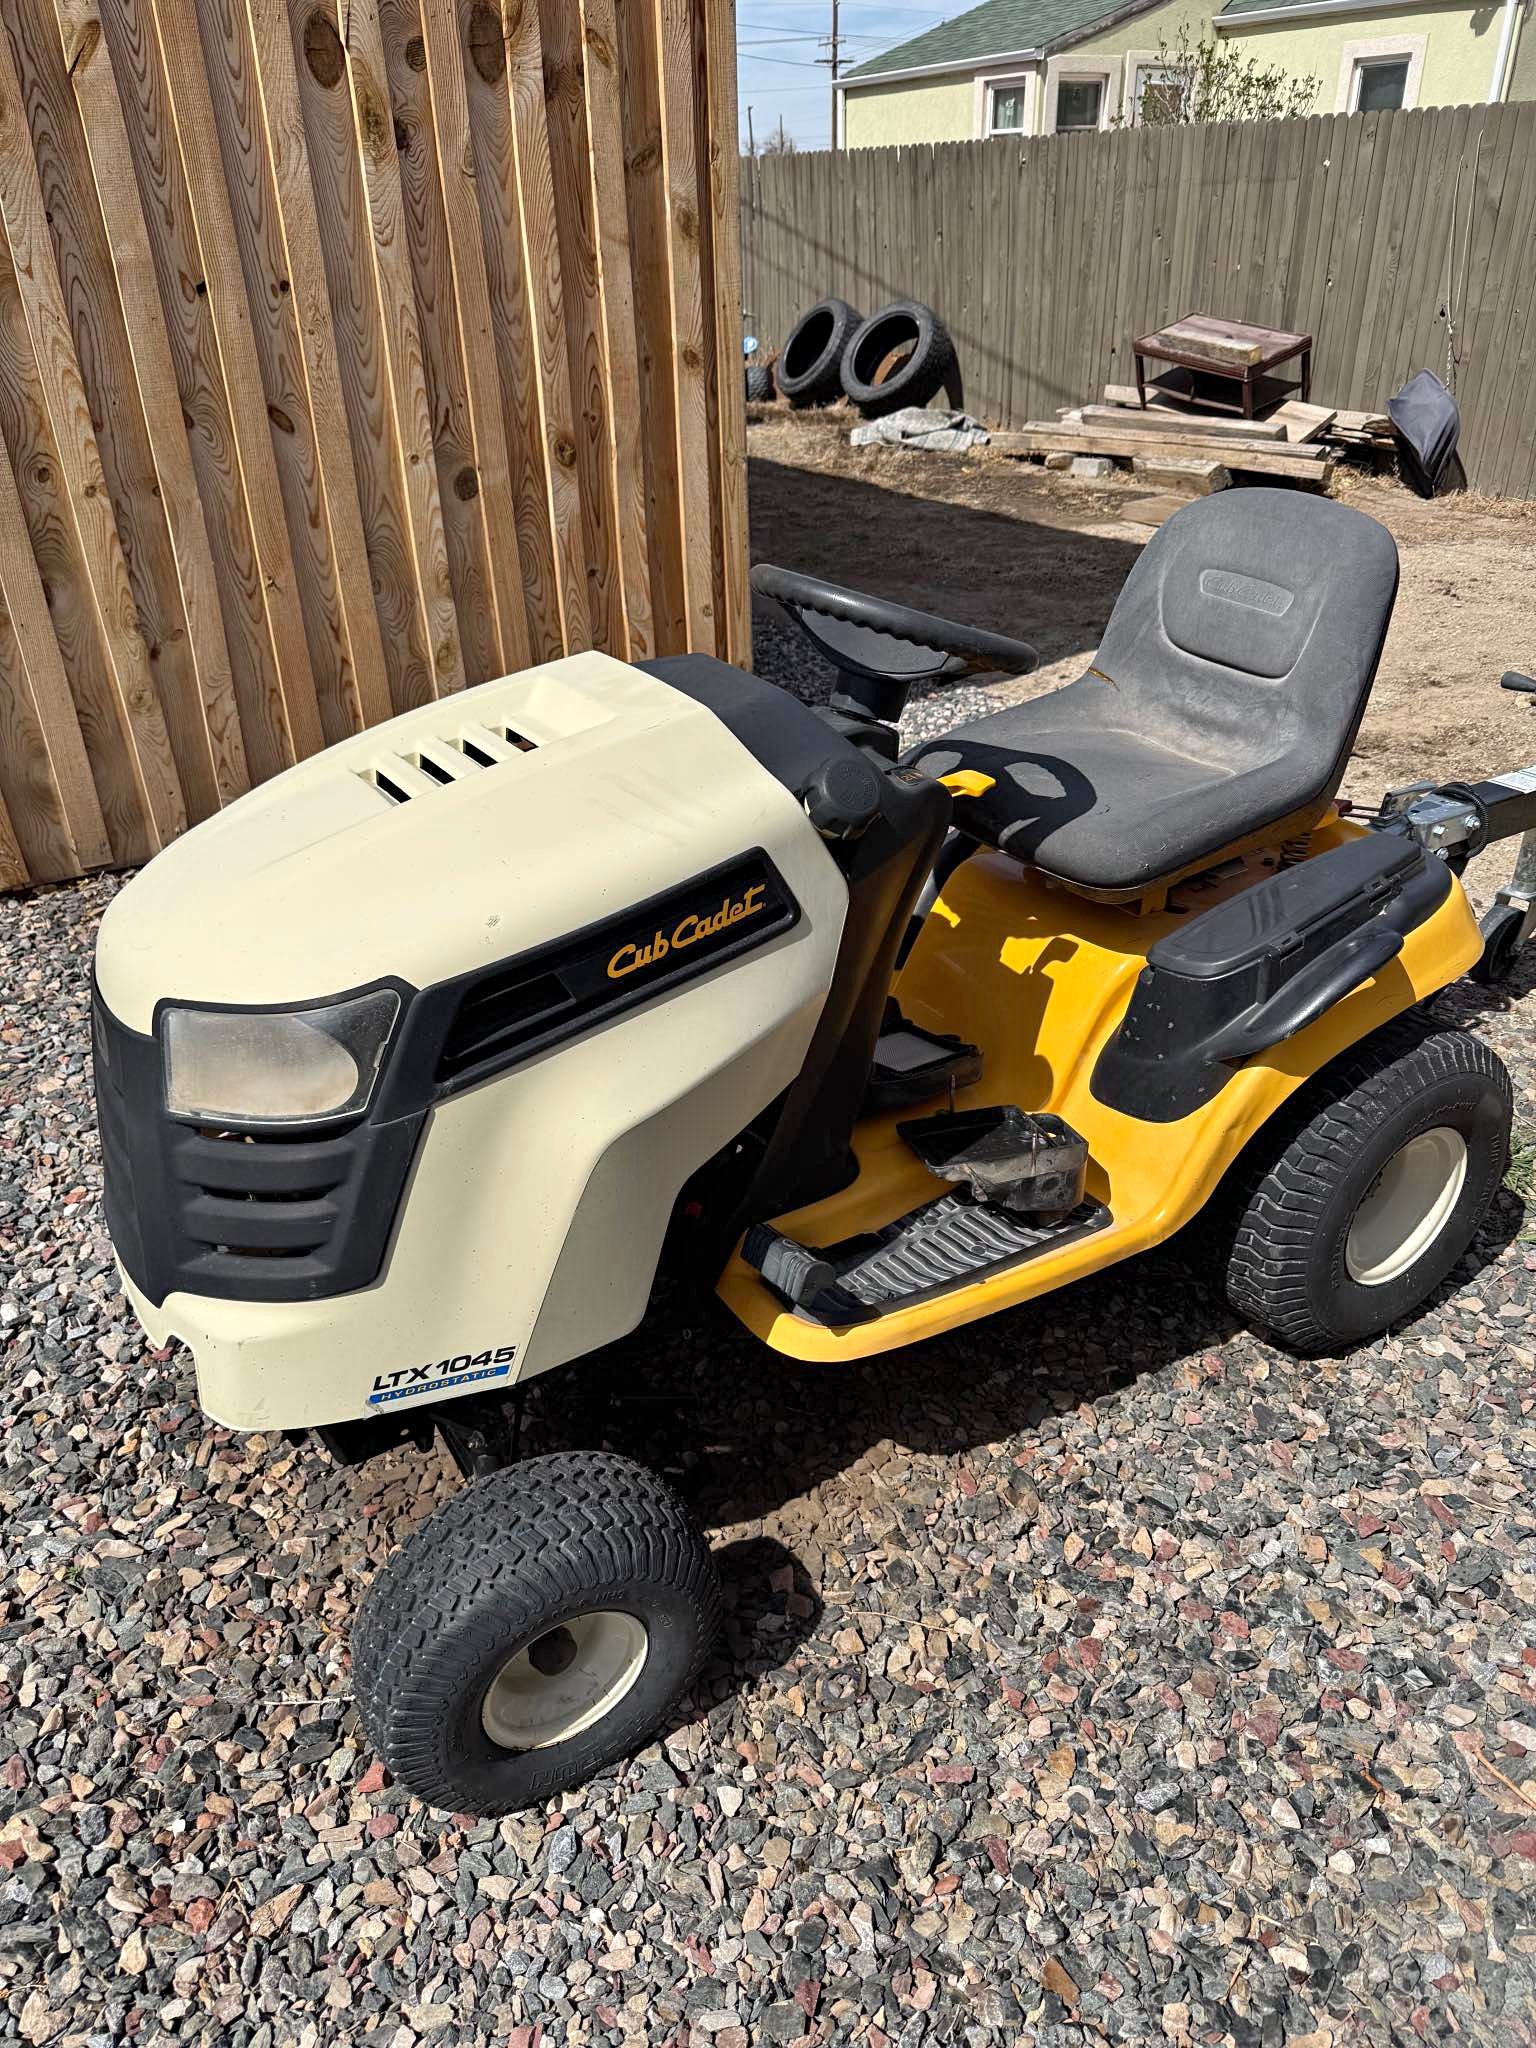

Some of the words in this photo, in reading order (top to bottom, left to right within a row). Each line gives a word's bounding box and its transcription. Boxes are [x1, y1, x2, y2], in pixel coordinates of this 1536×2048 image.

[607, 930, 670, 979] Cub
[671, 883, 767, 949] Cadet
[372, 1363, 433, 1391] LTX
[436, 1345, 516, 1376] 1045
[380, 1369, 498, 1402] HYDROSTATIC
